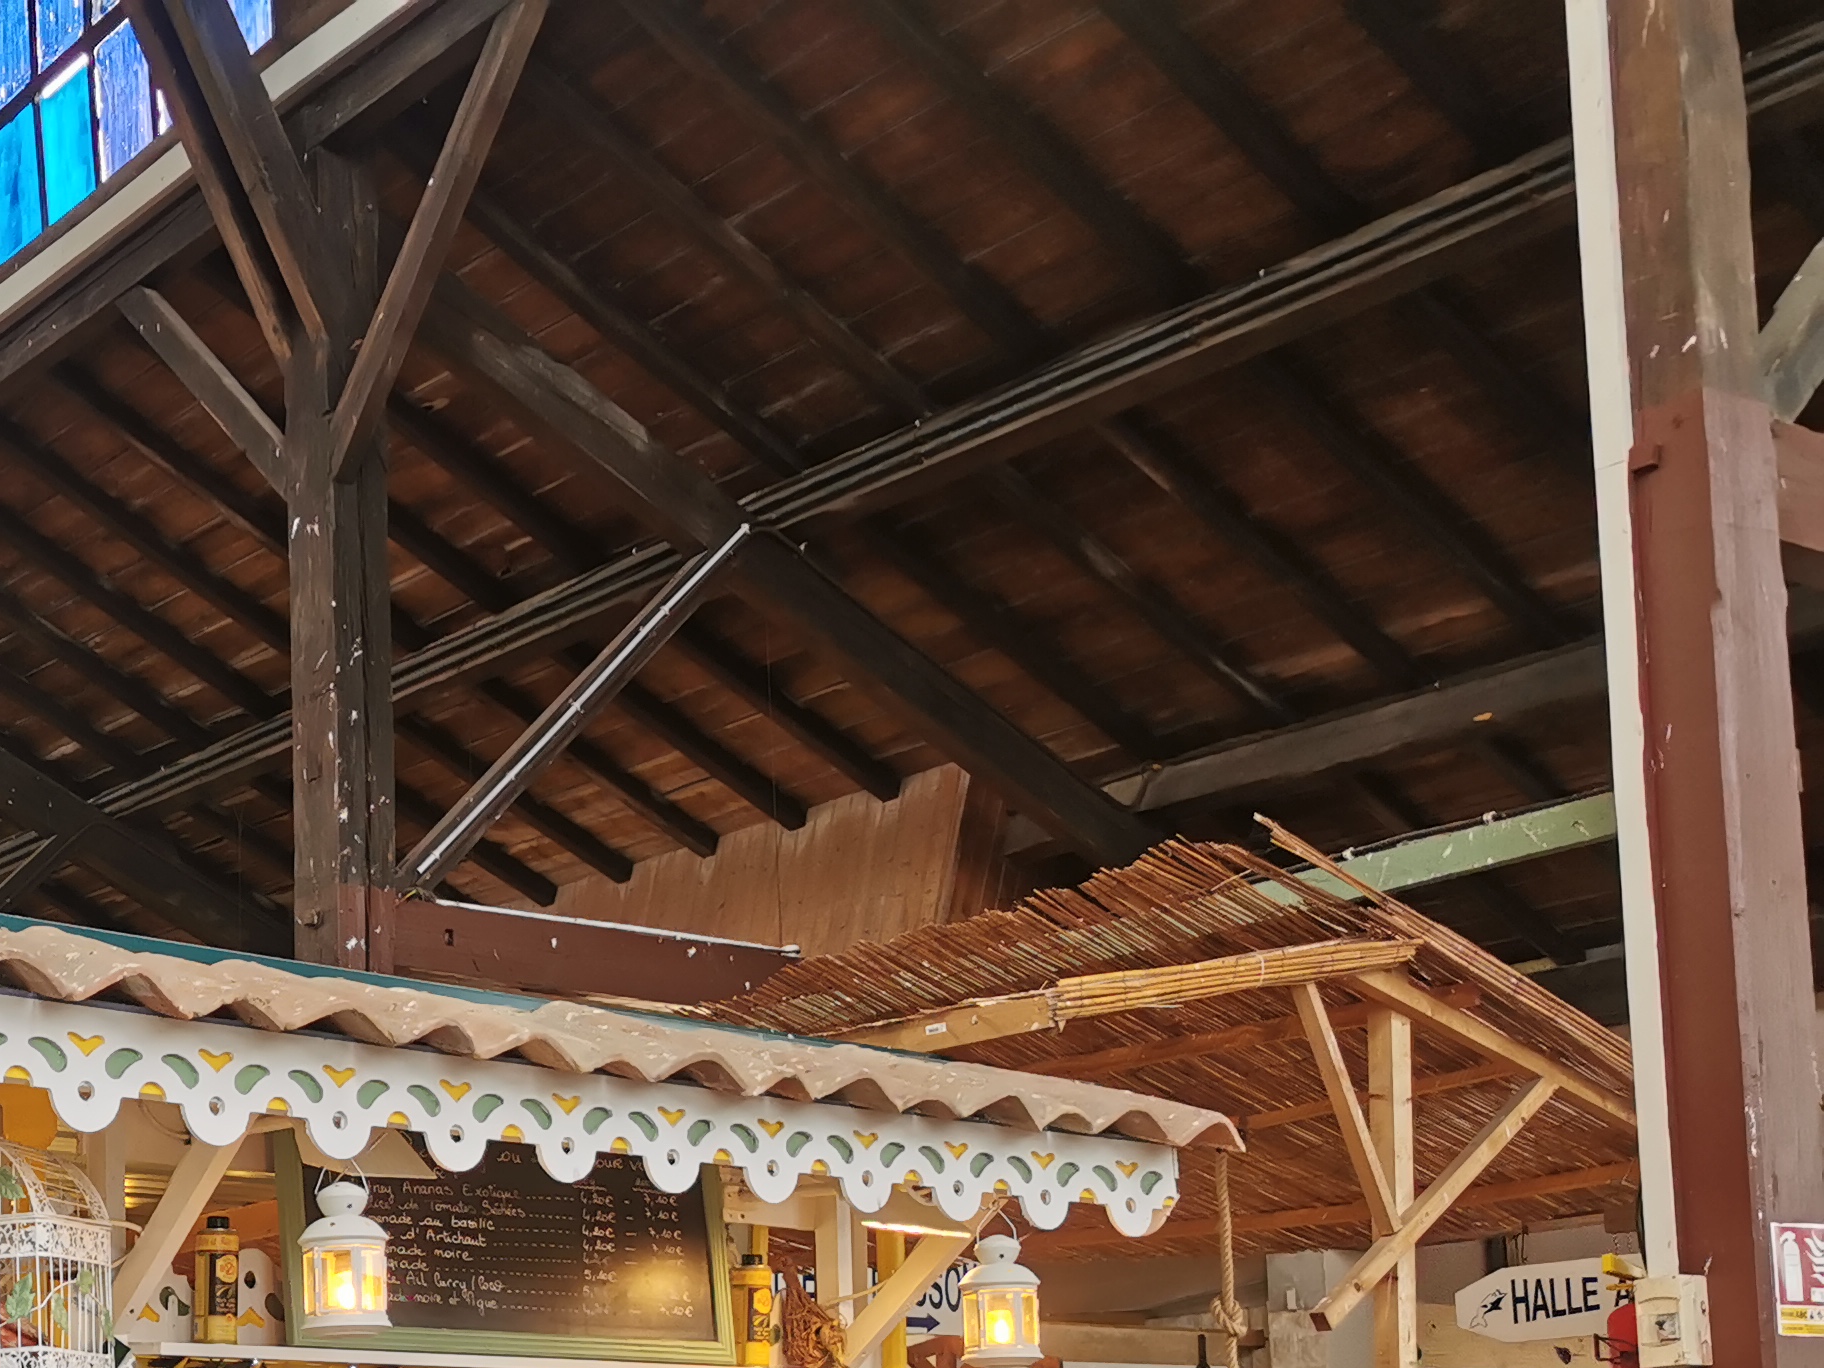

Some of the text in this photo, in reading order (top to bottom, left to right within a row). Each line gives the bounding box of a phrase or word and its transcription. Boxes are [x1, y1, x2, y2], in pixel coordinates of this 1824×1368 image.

[402, 1181, 454, 1196] Ananas
[426, 1228, 488, 1247] Artichaut
[1510, 1276, 1601, 1325] HALLE
